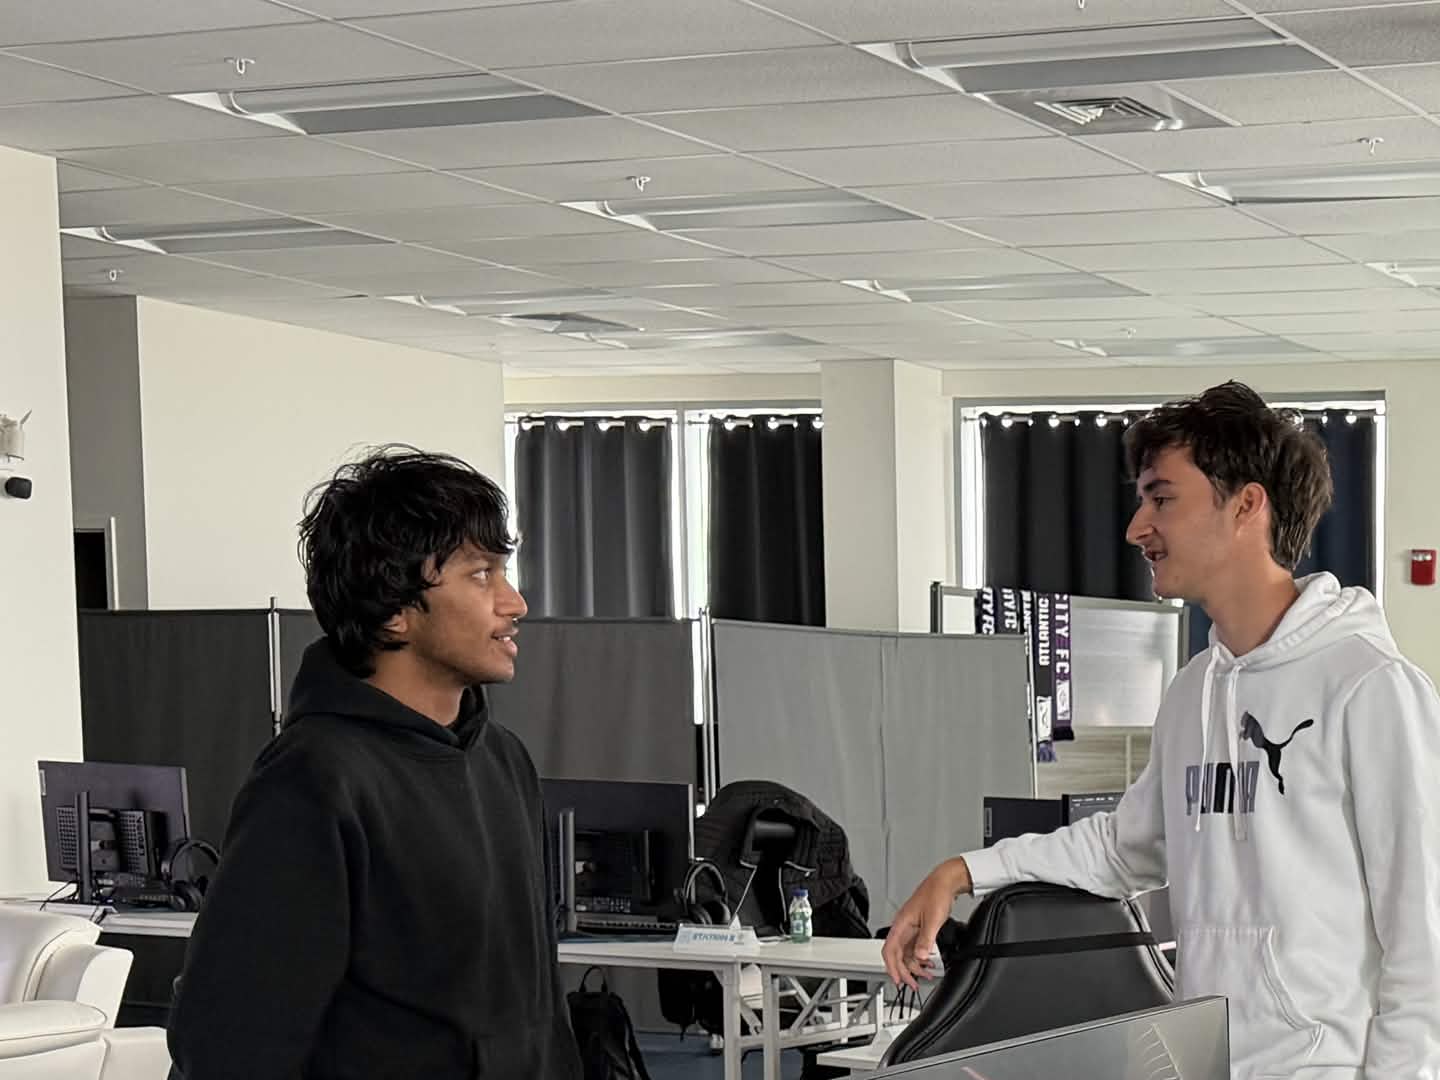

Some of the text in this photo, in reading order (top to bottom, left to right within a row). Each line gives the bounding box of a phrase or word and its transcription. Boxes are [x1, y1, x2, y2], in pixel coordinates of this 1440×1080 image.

[982, 587, 995, 635] ITY FC
[1001, 588, 1017, 629] ITY FC
[1038, 597, 1051, 666] ATLANTIC
[1055, 648, 1070, 675] FC
